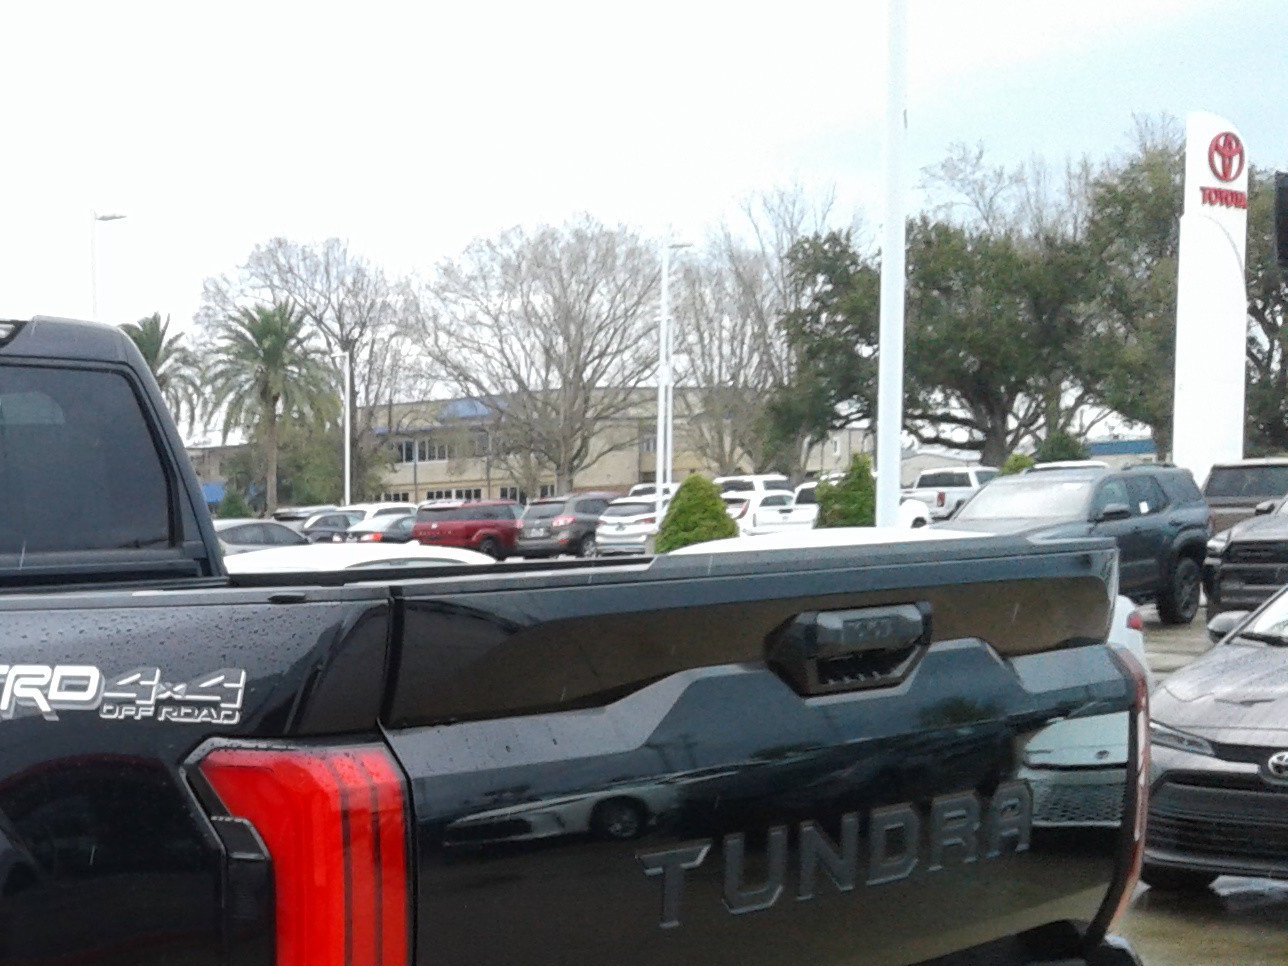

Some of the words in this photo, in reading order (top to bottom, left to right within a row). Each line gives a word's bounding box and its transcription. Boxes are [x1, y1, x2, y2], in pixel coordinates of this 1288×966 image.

[99, 703, 155, 720] OFF
[158, 706, 241, 725] ROAD
[636, 779, 1034, 929] TUNDRA
